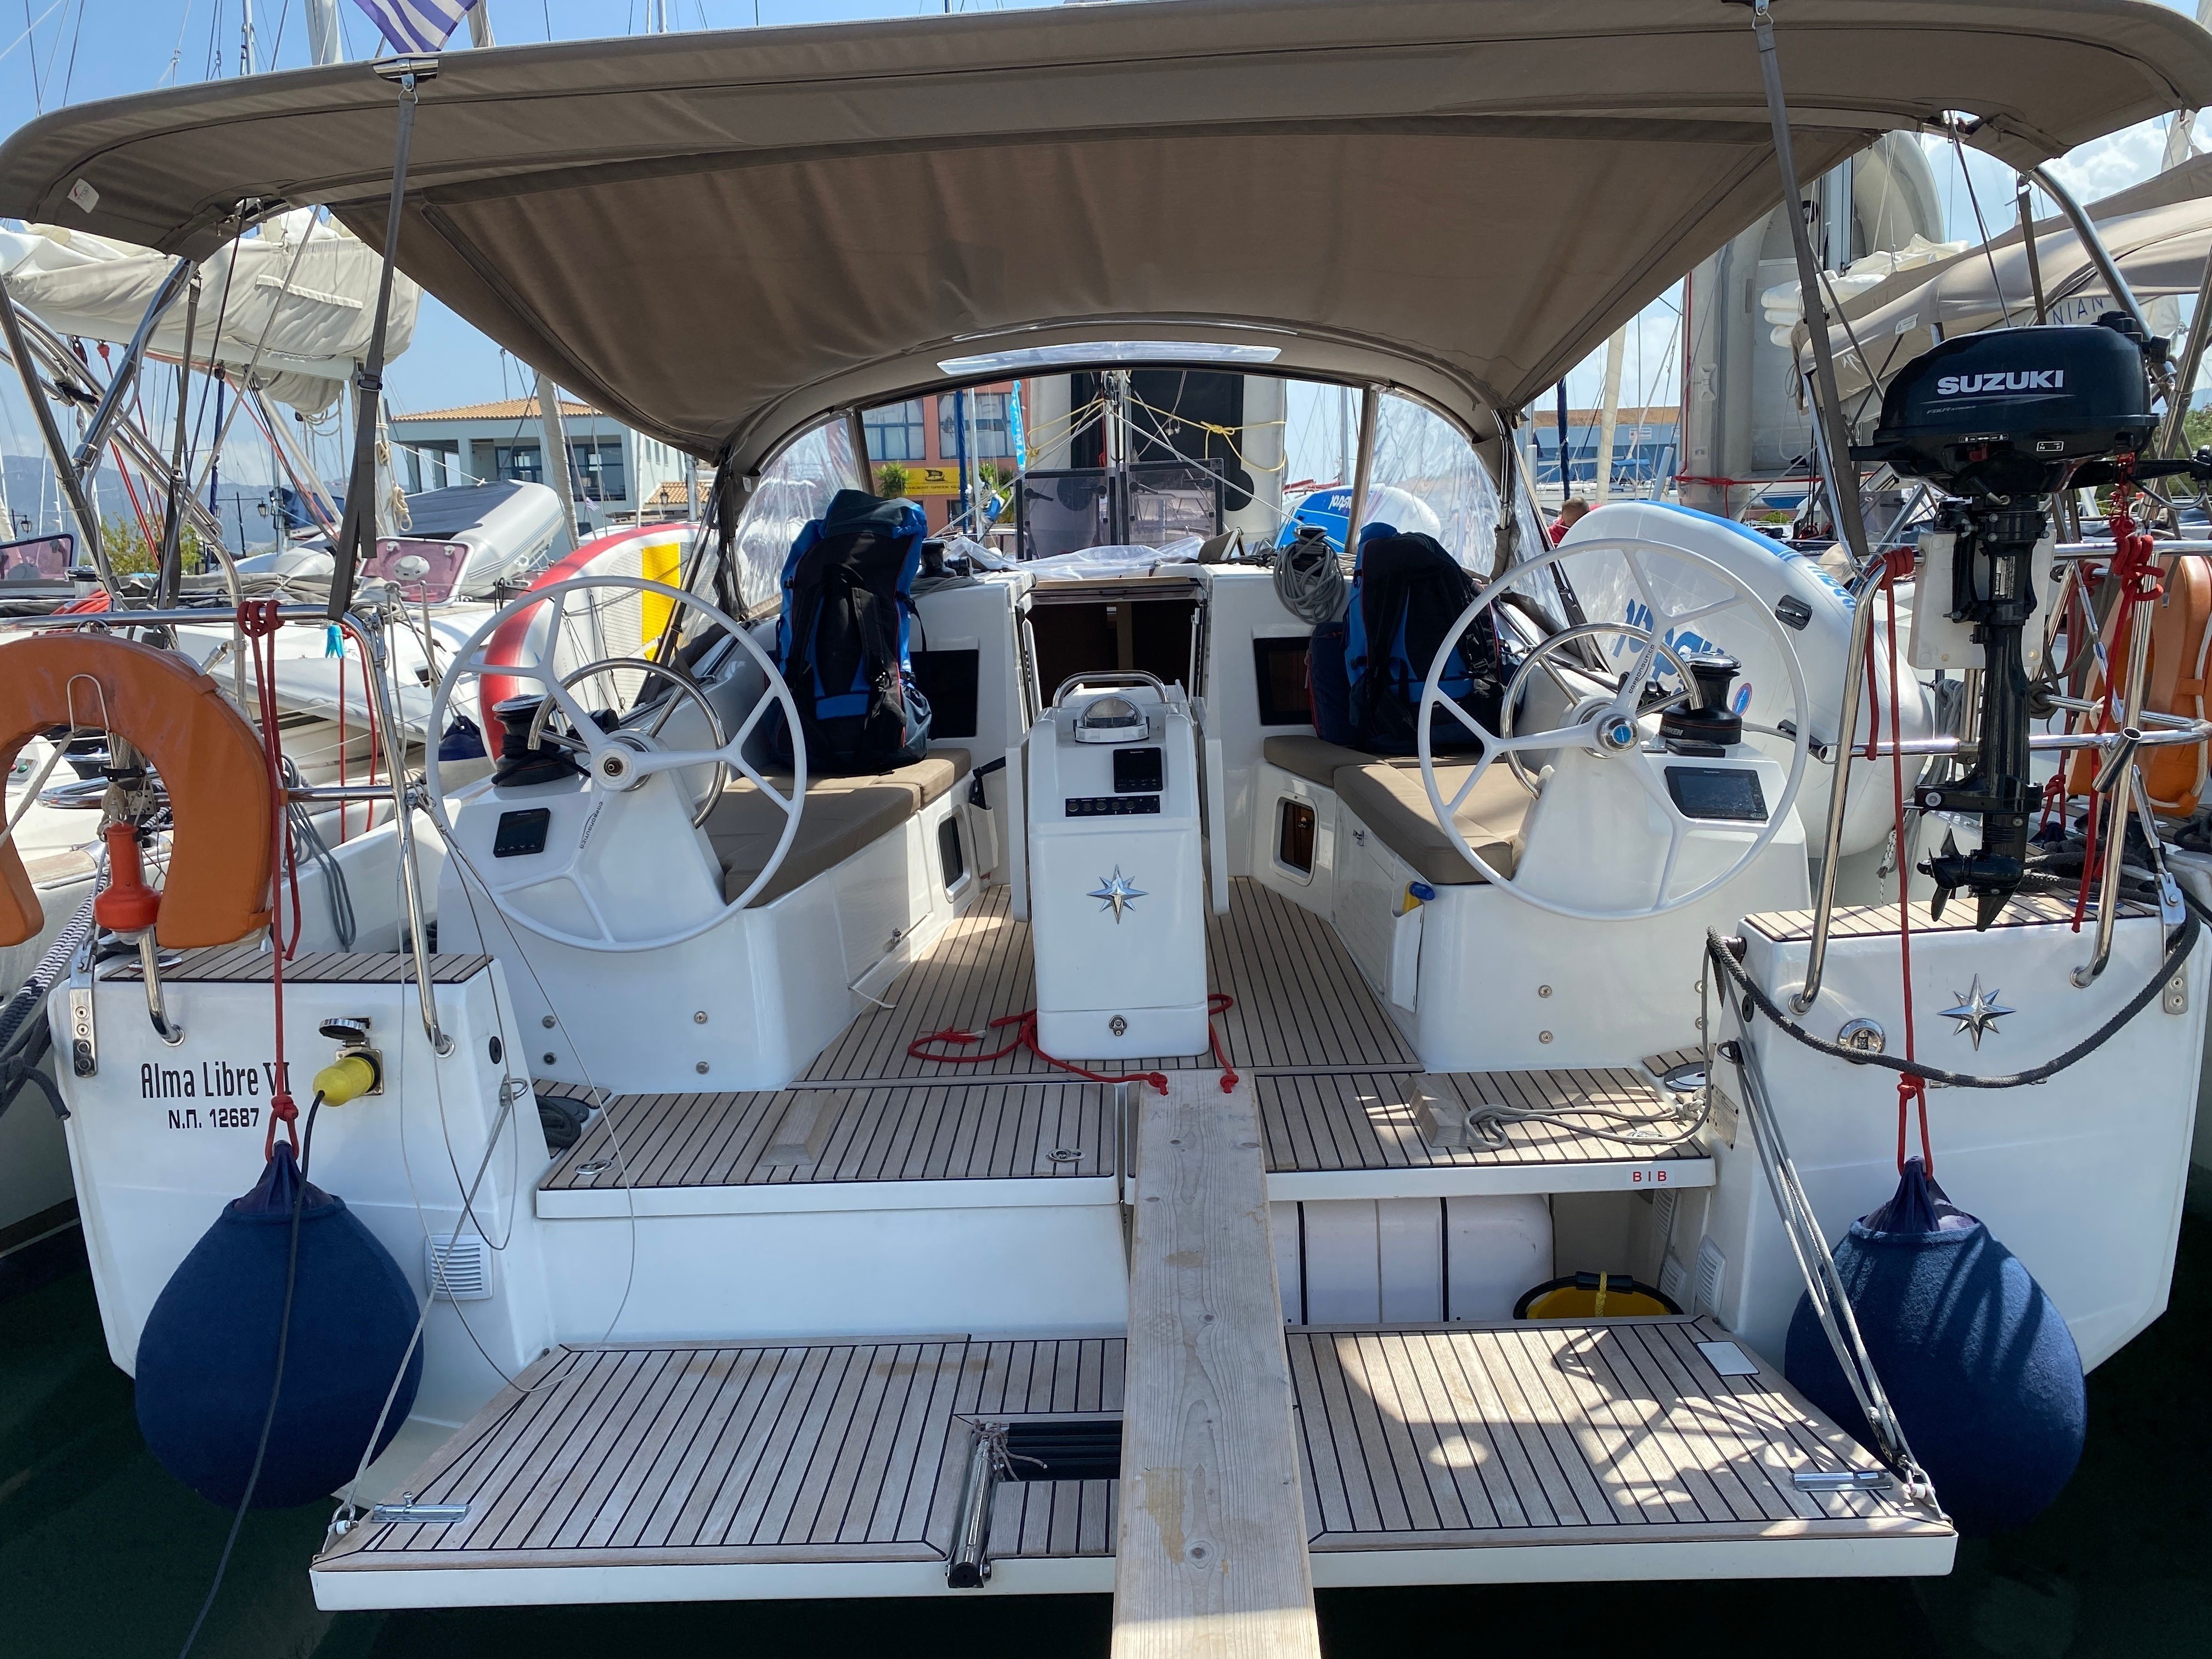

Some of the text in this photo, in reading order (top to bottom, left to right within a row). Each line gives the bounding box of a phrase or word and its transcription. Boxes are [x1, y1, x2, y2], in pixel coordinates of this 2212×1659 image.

[2052, 298, 2104, 325] NIAN
[1937, 370, 2064, 394] SUZUKI
[141, 1063, 195, 1098] Alma
[203, 1061, 259, 1097] Libre
[210, 1108, 259, 1128] 12687
